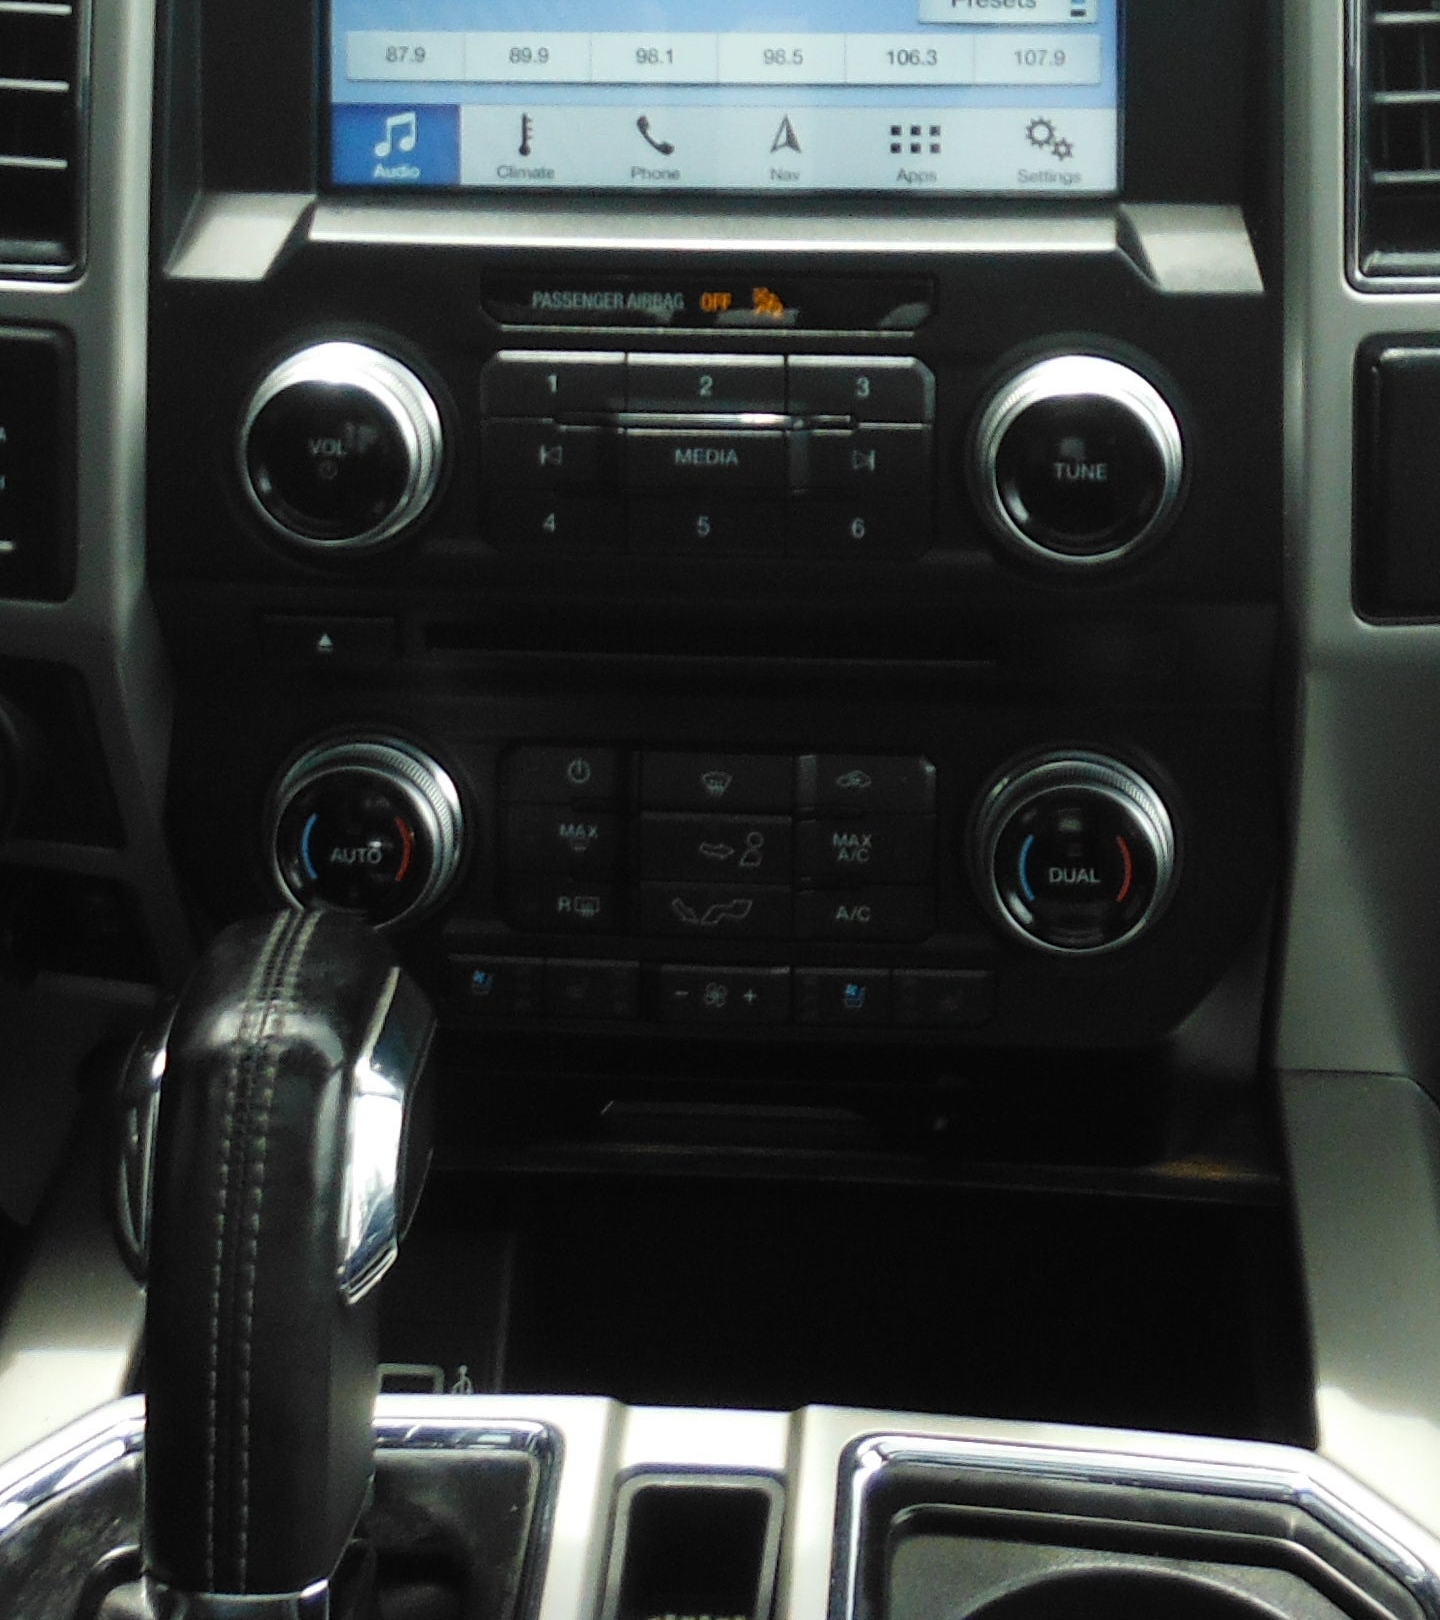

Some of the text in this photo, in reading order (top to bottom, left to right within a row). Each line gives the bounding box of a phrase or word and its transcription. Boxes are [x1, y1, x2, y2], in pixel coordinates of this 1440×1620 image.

[385, 46, 426, 64] 87.9
[509, 47, 549, 65] 89.9
[635, 48, 674, 66] 98.1
[763, 48, 804, 66] 98.5
[886, 49, 938, 67] 106.3
[1014, 49, 1067, 67] 107.9
[373, 162, 421, 181] Audio
[496, 164, 556, 182] Climate
[630, 165, 681, 182] Phone
[770, 167, 801, 183] Nav
[897, 167, 938, 187] Apps
[1017, 167, 1081, 187] Settings
[531, 291, 733, 312] PASSENGER AIRBAG OFF
[546, 374, 559, 394] 1
[698, 376, 714, 396] 2
[854, 377, 871, 398] 3
[309, 436, 348, 456] VOL
[675, 448, 740, 467] MEDIA
[1053, 462, 1107, 480] TUNE
[543, 514, 556, 533] 4
[696, 517, 713, 538] 5
[850, 517, 866, 539] 6
[559, 823, 599, 840] MAX
[832, 833, 872, 849] MAX
[330, 847, 384, 864] AUTO
[837, 847, 871, 863] A/C
[1048, 866, 1101, 883] DUAL
[558, 896, 572, 912] R
[835, 905, 871, 922] A/C
